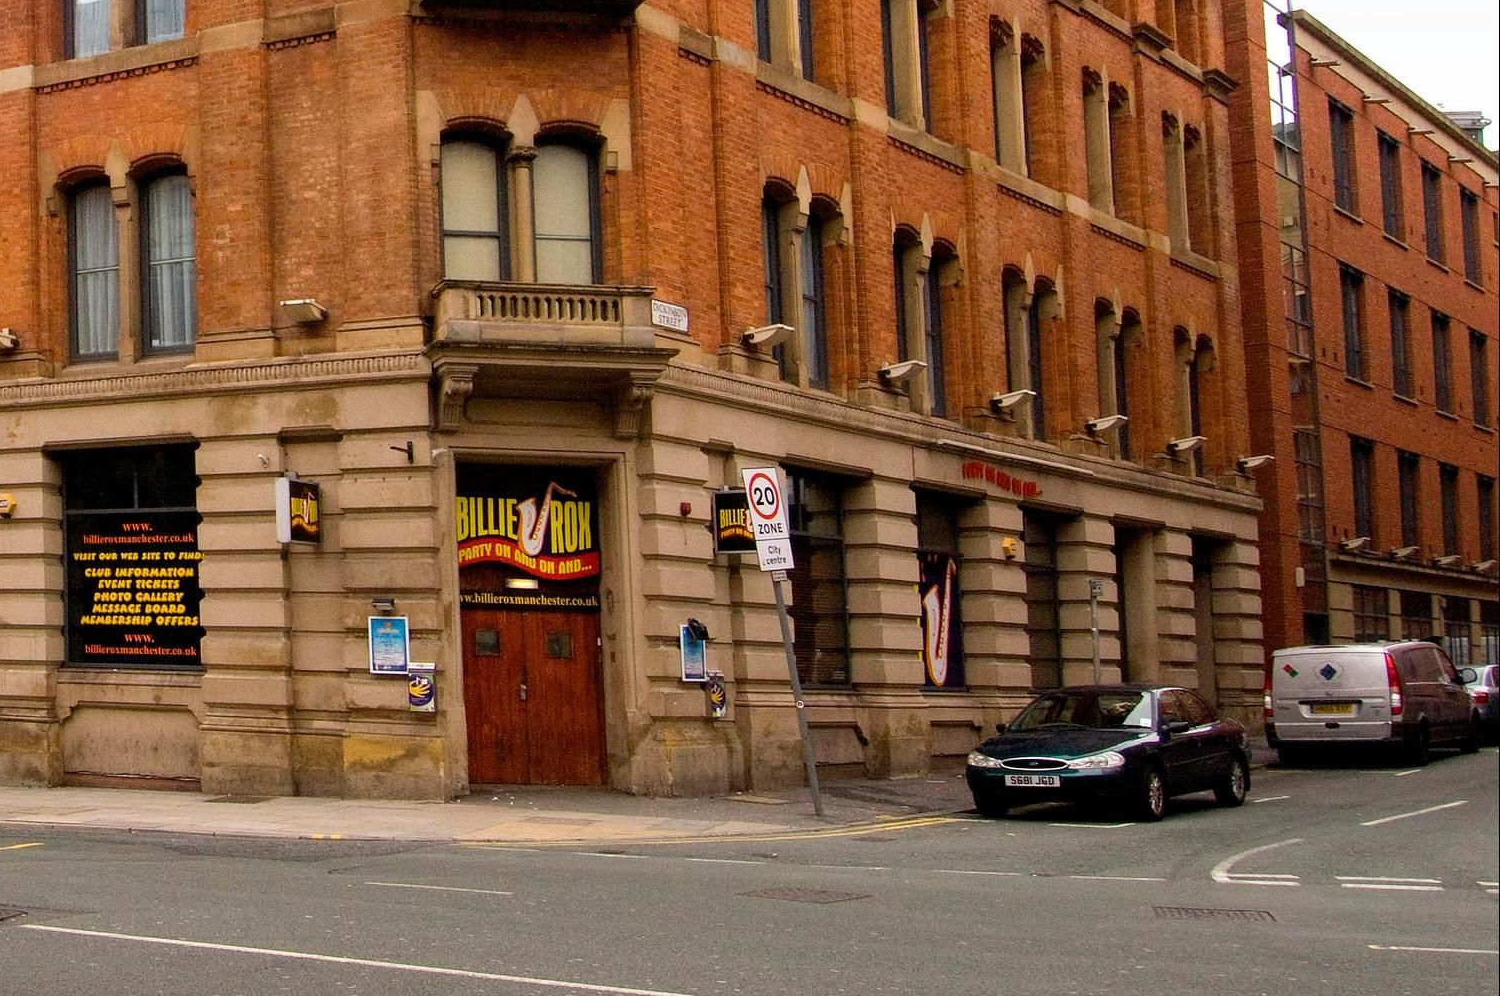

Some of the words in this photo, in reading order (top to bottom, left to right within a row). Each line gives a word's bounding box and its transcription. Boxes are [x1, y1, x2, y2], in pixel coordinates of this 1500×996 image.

[659, 314, 681, 327] STREET
[754, 487, 775, 505] 20
[720, 509, 746, 529] BILLIE
[455, 496, 518, 542] BILLIE
[551, 501, 592, 554] ROX
[758, 522, 783, 535] ZONE
[83, 533, 194, 544] billieroxmanchester.co.uk
[73, 552, 96, 561] VISIT
[99, 552, 118, 561] OUR
[120, 552, 139, 561] WEB
[141, 552, 161, 560] SITE
[164, 552, 176, 560] TO
[768, 546, 782, 559] City
[458, 543, 492, 563] PARTY
[495, 543, 511, 559] ON
[514, 549, 537, 569] AND
[539, 559, 555, 574] ON
[558, 558, 592, 575] AND...
[766, 555, 787, 566] centre
[84, 568, 112, 577] CLUB
[115, 567, 194, 577] INFORMATION
[98, 579, 132, 589] EVENT
[135, 579, 180, 589] TICKETS
[94, 592, 132, 602] PHOTO
[136, 592, 184, 602] GALLERY
[92, 604, 141, 613] MESSAGE
[145, 604, 186, 614] BOARD
[81, 615, 152, 625] MEMBERSHIP
[156, 616, 199, 626] OFFERS
[85, 644, 197, 656] billieroxmanchester.co.uk
